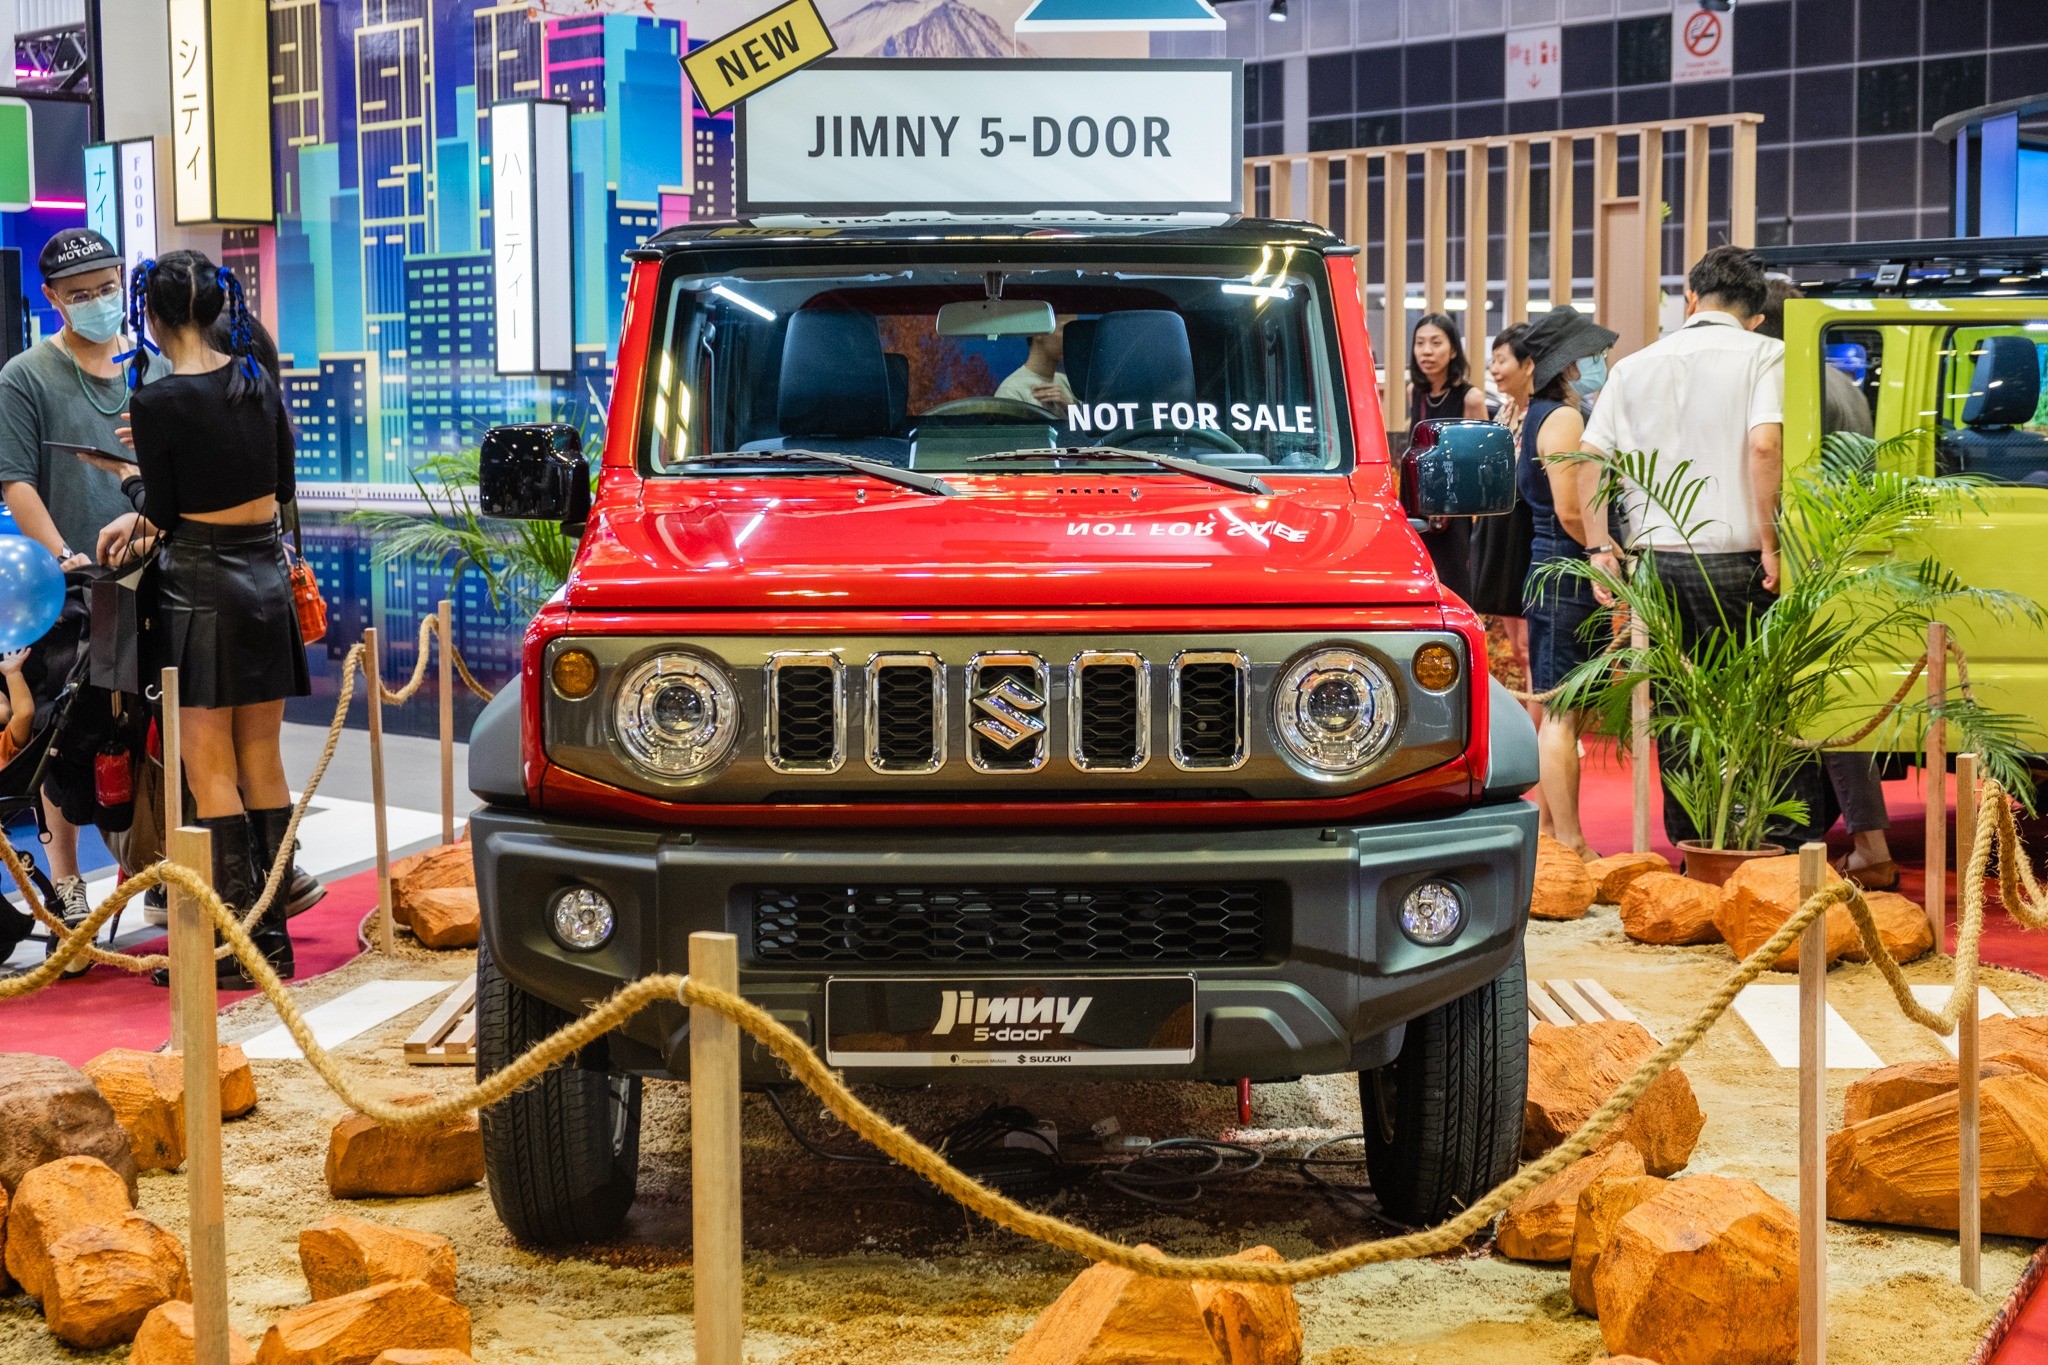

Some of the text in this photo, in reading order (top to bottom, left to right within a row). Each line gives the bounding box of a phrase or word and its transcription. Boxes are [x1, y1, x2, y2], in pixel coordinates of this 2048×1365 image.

[714, 20, 801, 88] NEW
[807, 115, 1172, 158] JIMNY 5-DOOR
[133, 156, 143, 228] FOOD
[57, 241, 104, 264] MOTORS
[1067, 402, 1315, 434] NOT FOR SALE
[931, 990, 1093, 1035] Jimny
[973, 1027, 1052, 1042] 5-door
[1029, 1055, 1072, 1063] SUZUKI
